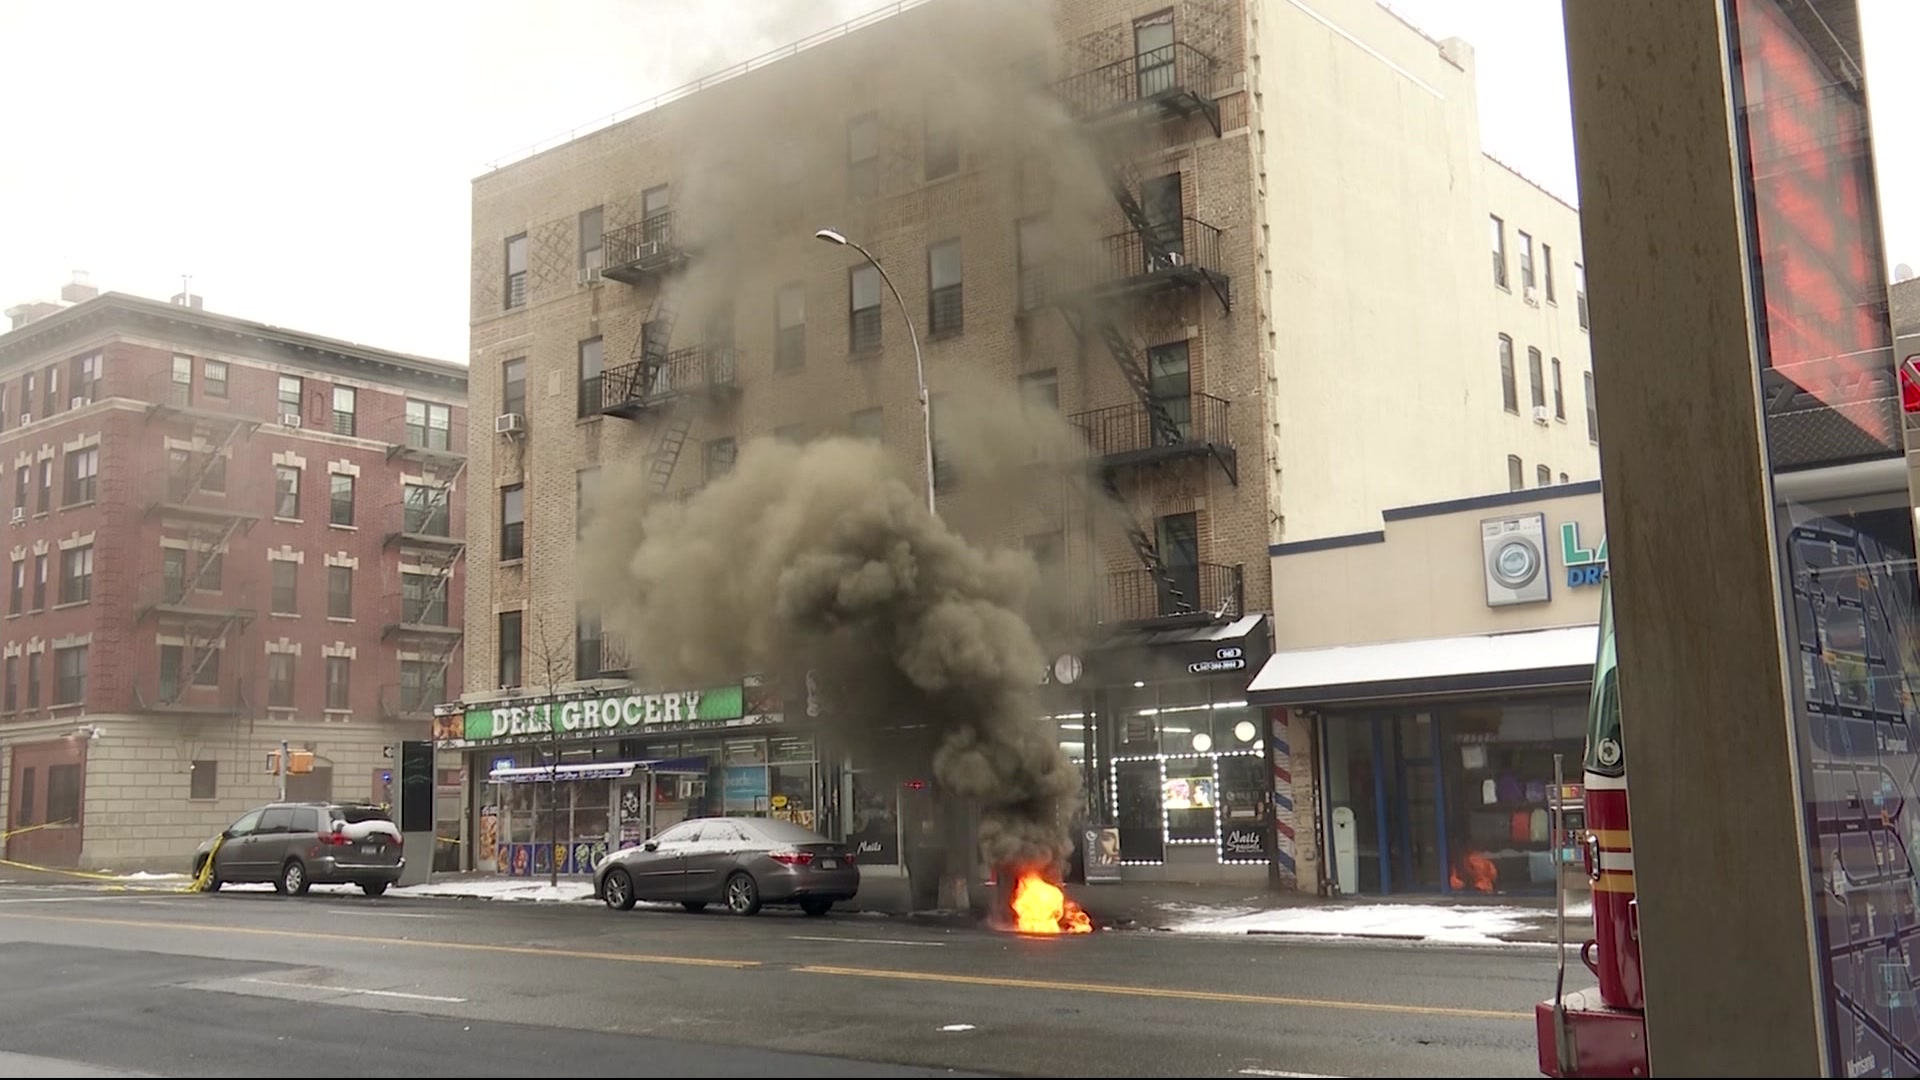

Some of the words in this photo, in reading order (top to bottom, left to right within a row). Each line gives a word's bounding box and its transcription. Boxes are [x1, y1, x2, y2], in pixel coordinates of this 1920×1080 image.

[491, 704, 553, 737] DELI
[561, 691, 701, 731] GROCERY
[1226, 830, 1260, 845] Nails
[856, 840, 882, 855] Nails
